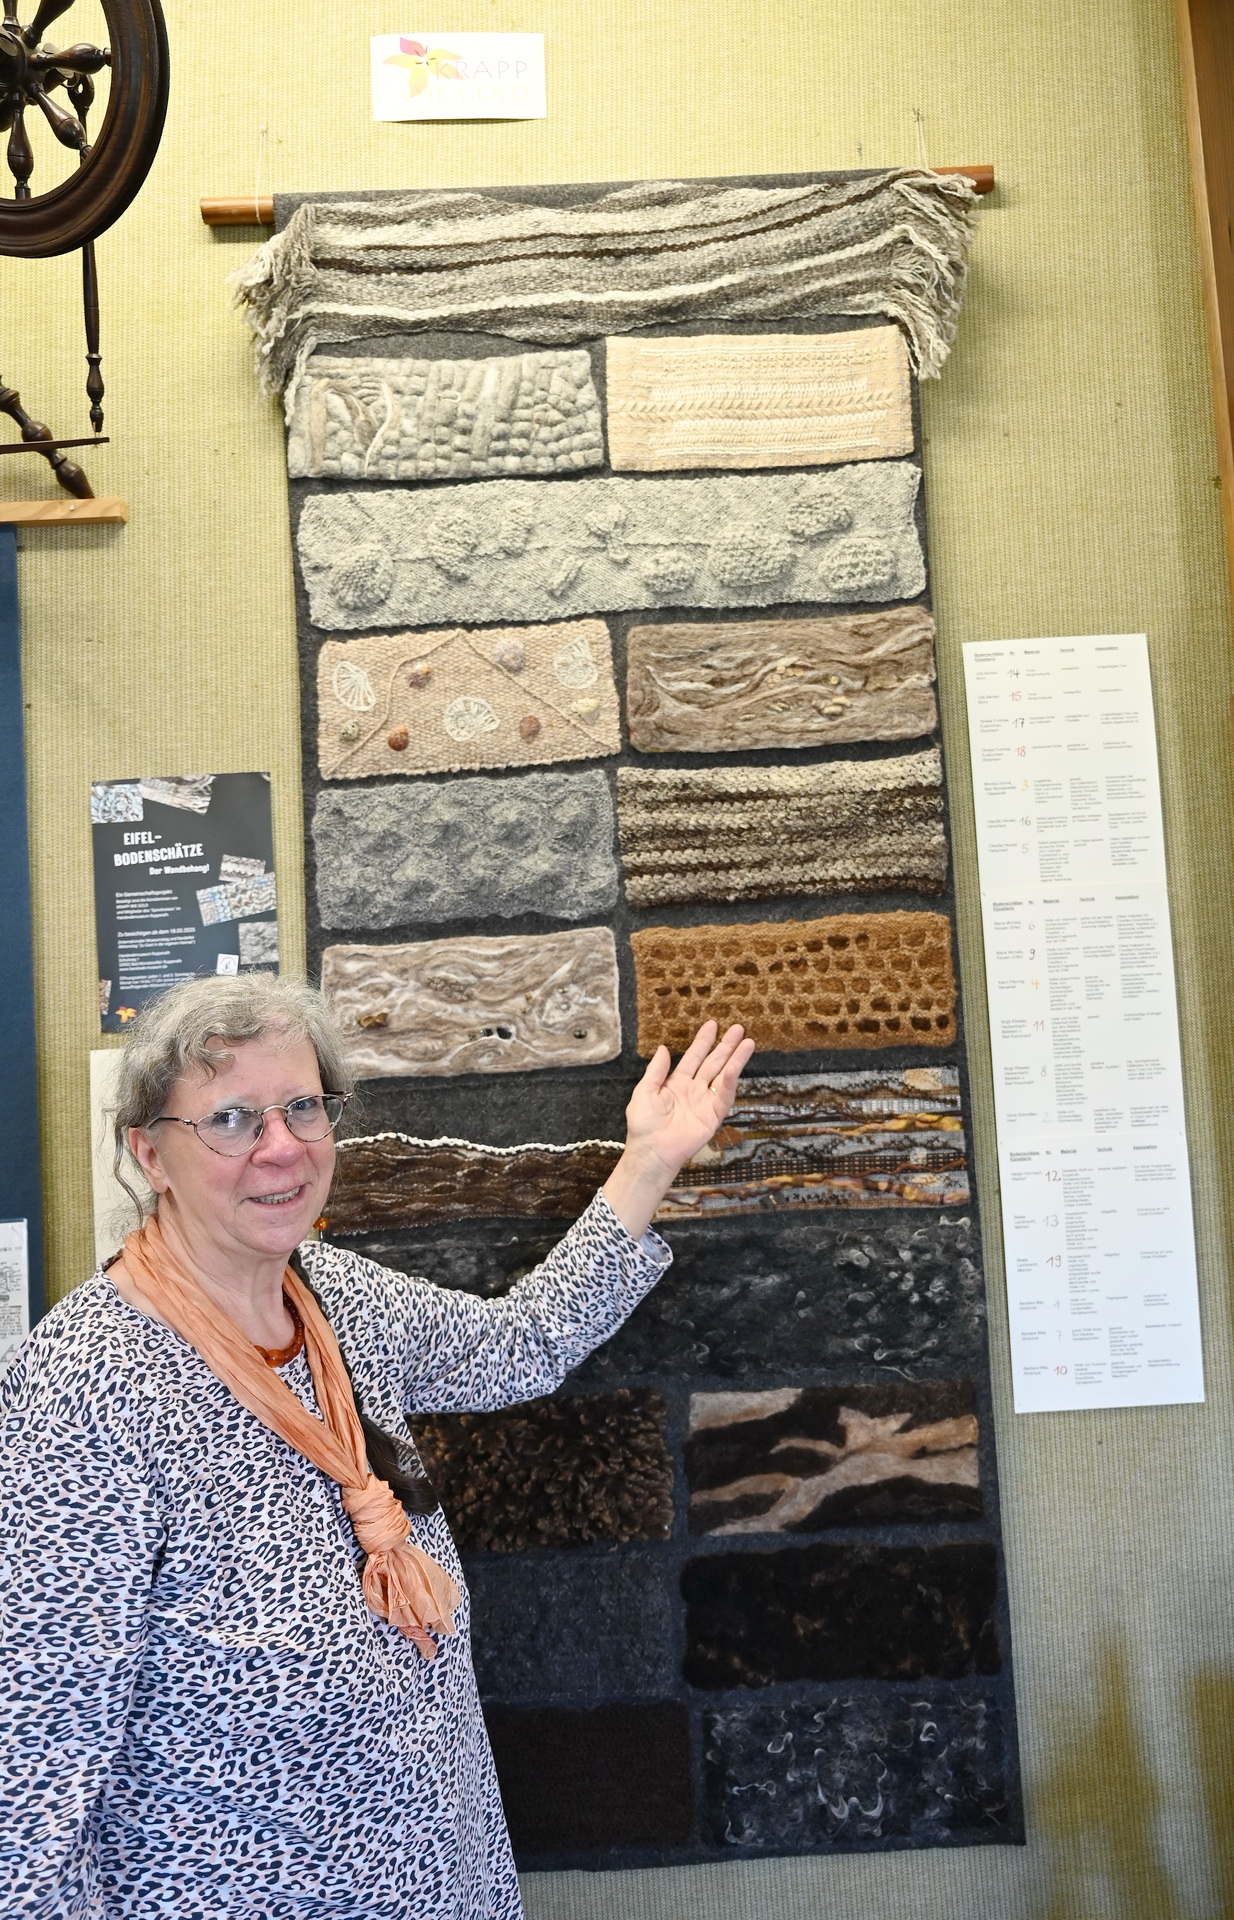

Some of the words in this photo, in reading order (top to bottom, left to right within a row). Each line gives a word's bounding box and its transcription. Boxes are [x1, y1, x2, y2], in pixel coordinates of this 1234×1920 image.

[436, 60, 527, 80] KRAPP
[1007, 669, 1020, 679] 14
[1009, 691, 1022, 701] 15
[1012, 717, 1025, 729] 17
[1014, 746, 1026, 757] 18
[1021, 779, 1029, 791] 3
[1019, 816, 1031, 826] 16
[124, 831, 162, 845] EIFEL-
[114, 842, 204, 866] BODENSCHÄTZE
[1021, 842, 1029, 854] 5
[149, 867, 163, 875] Der
[1028, 920, 1035, 930] 6
[1029, 948, 1036, 960] 9
[1031, 979, 1039, 990] 4
[1033, 1019, 1045, 1032] 11
[1040, 1065, 1047, 1077] 8
[1042, 1111, 1052, 1123] 2
[1044, 1170, 1061, 1182] 12
[1042, 1214, 1059, 1227] 13
[1046, 1255, 1061, 1267] 19
[1054, 1365, 1068, 1376] 10
